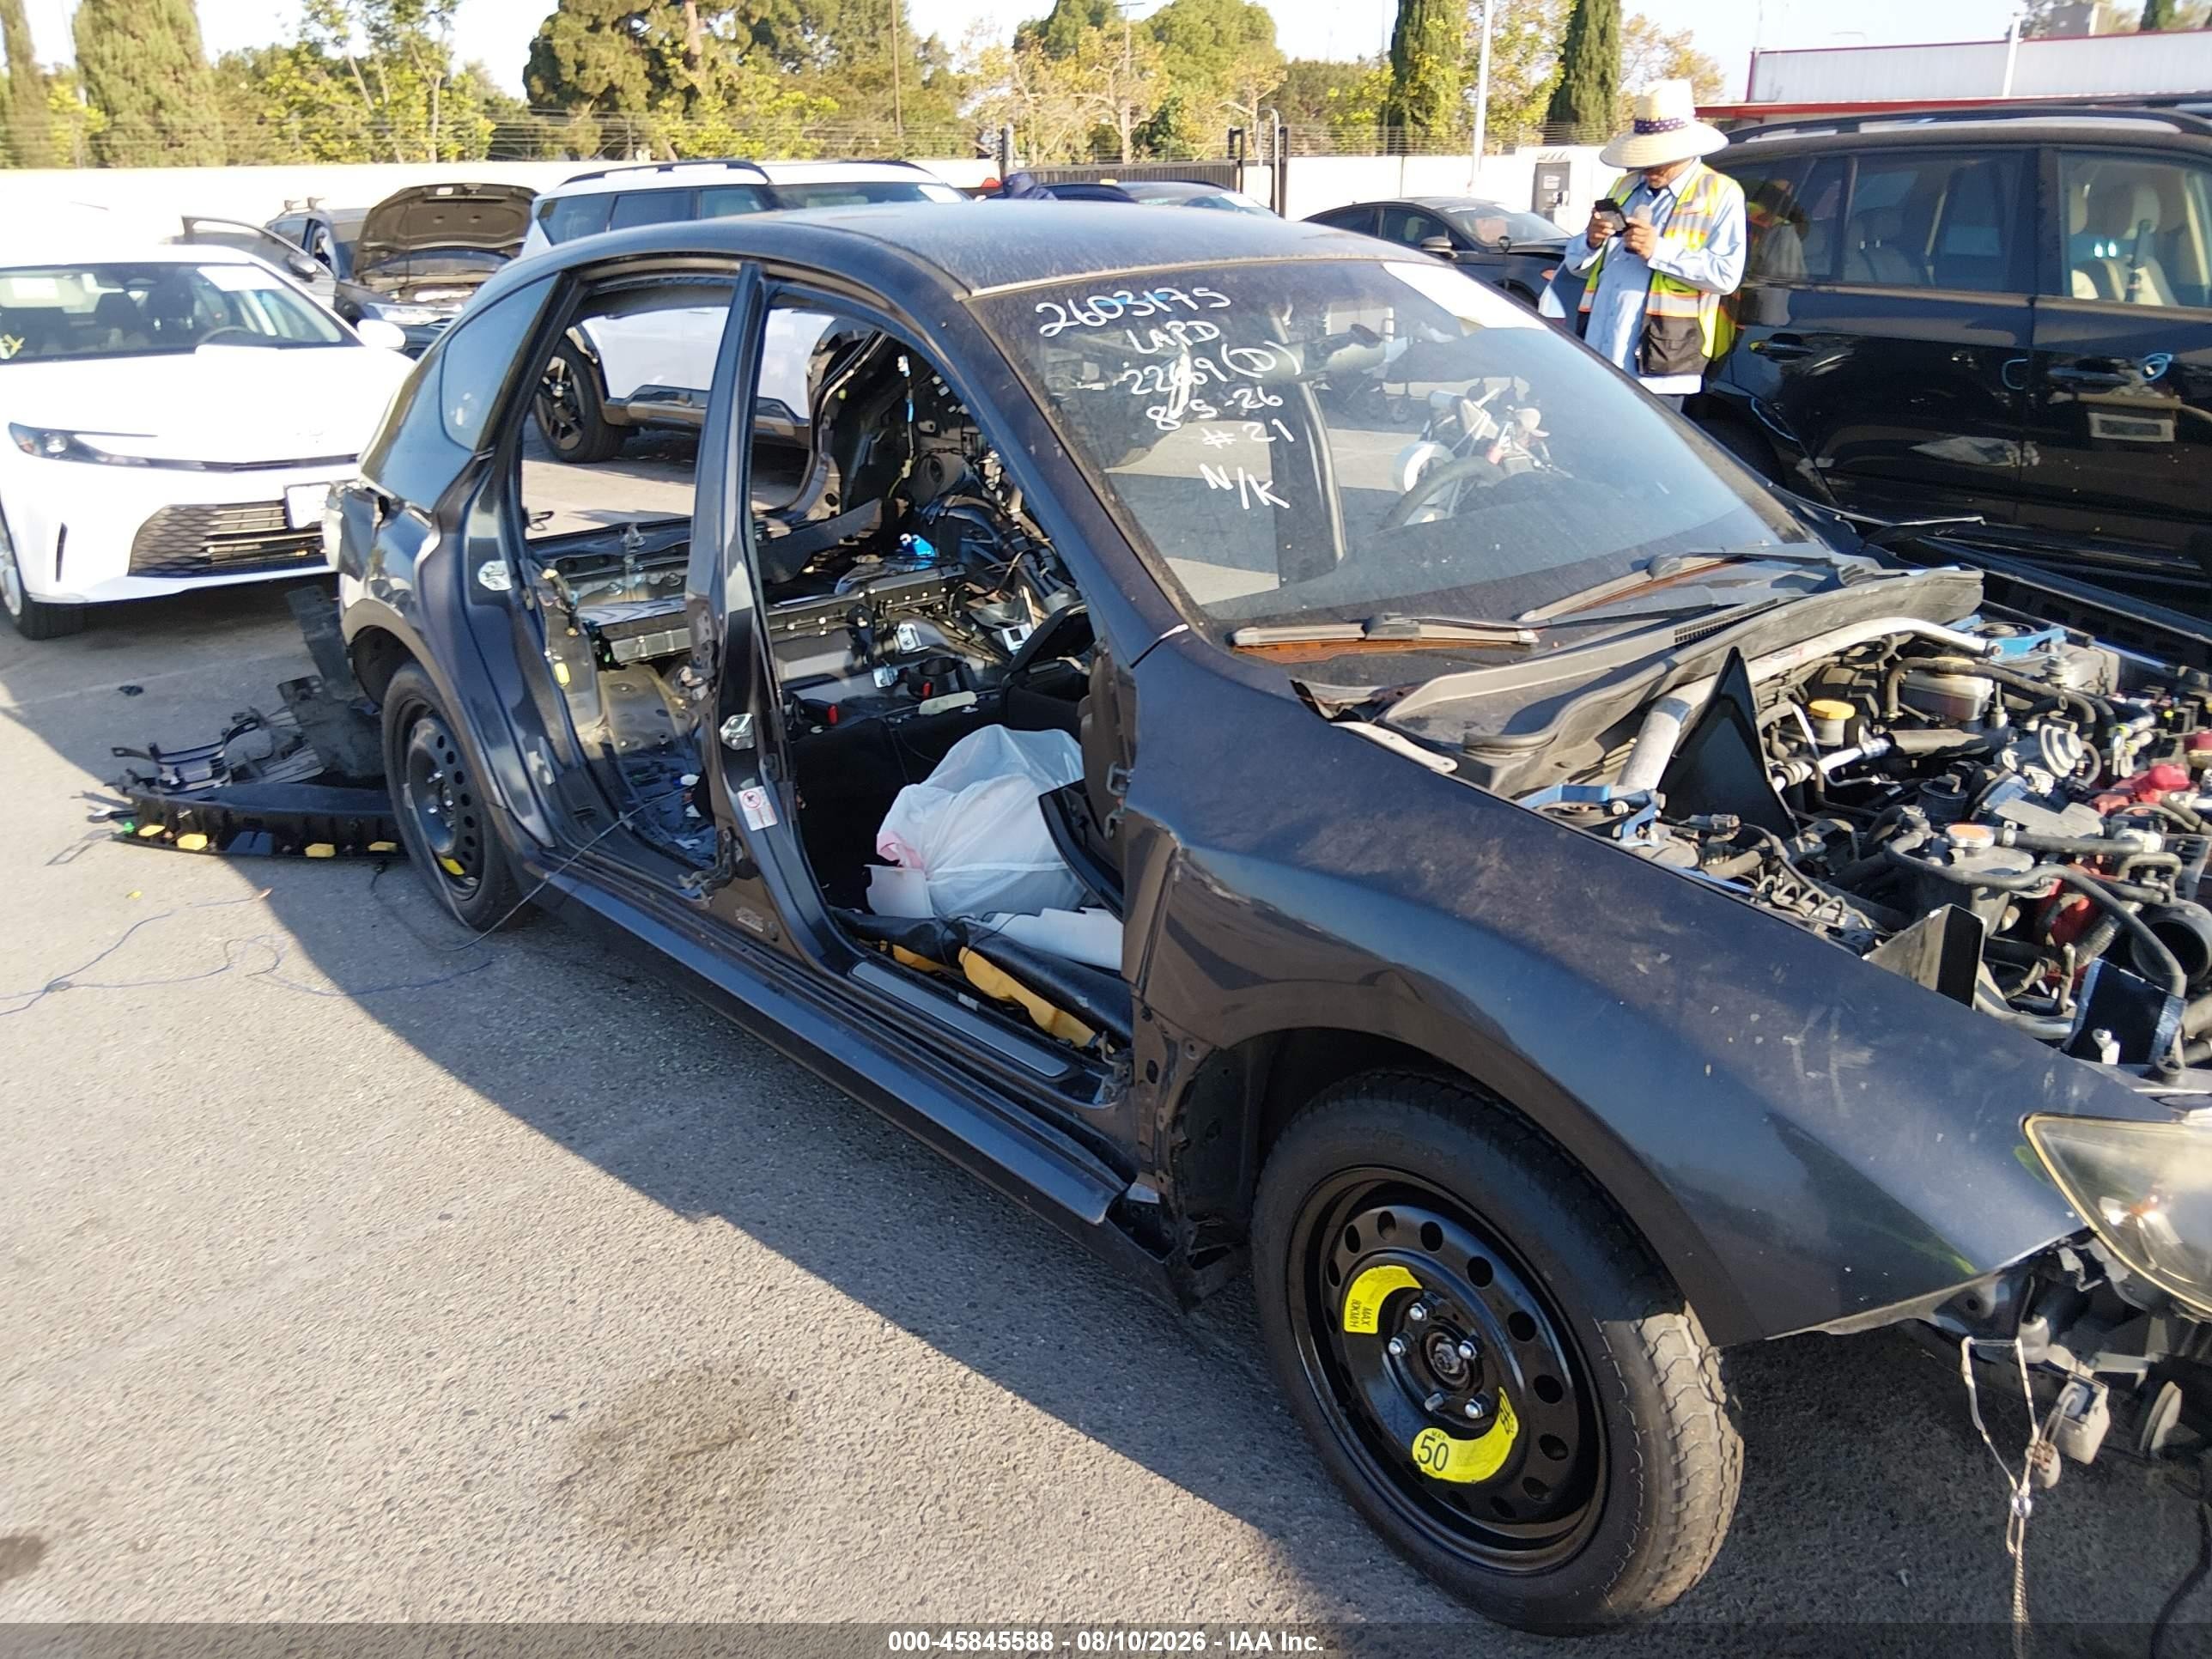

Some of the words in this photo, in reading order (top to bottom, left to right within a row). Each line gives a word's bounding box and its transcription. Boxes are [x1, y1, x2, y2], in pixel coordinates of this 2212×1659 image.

[1035, 287, 1232, 337] 2603175
[1126, 319, 1221, 355] LAPD
[1418, 1434, 1449, 1472] 50
